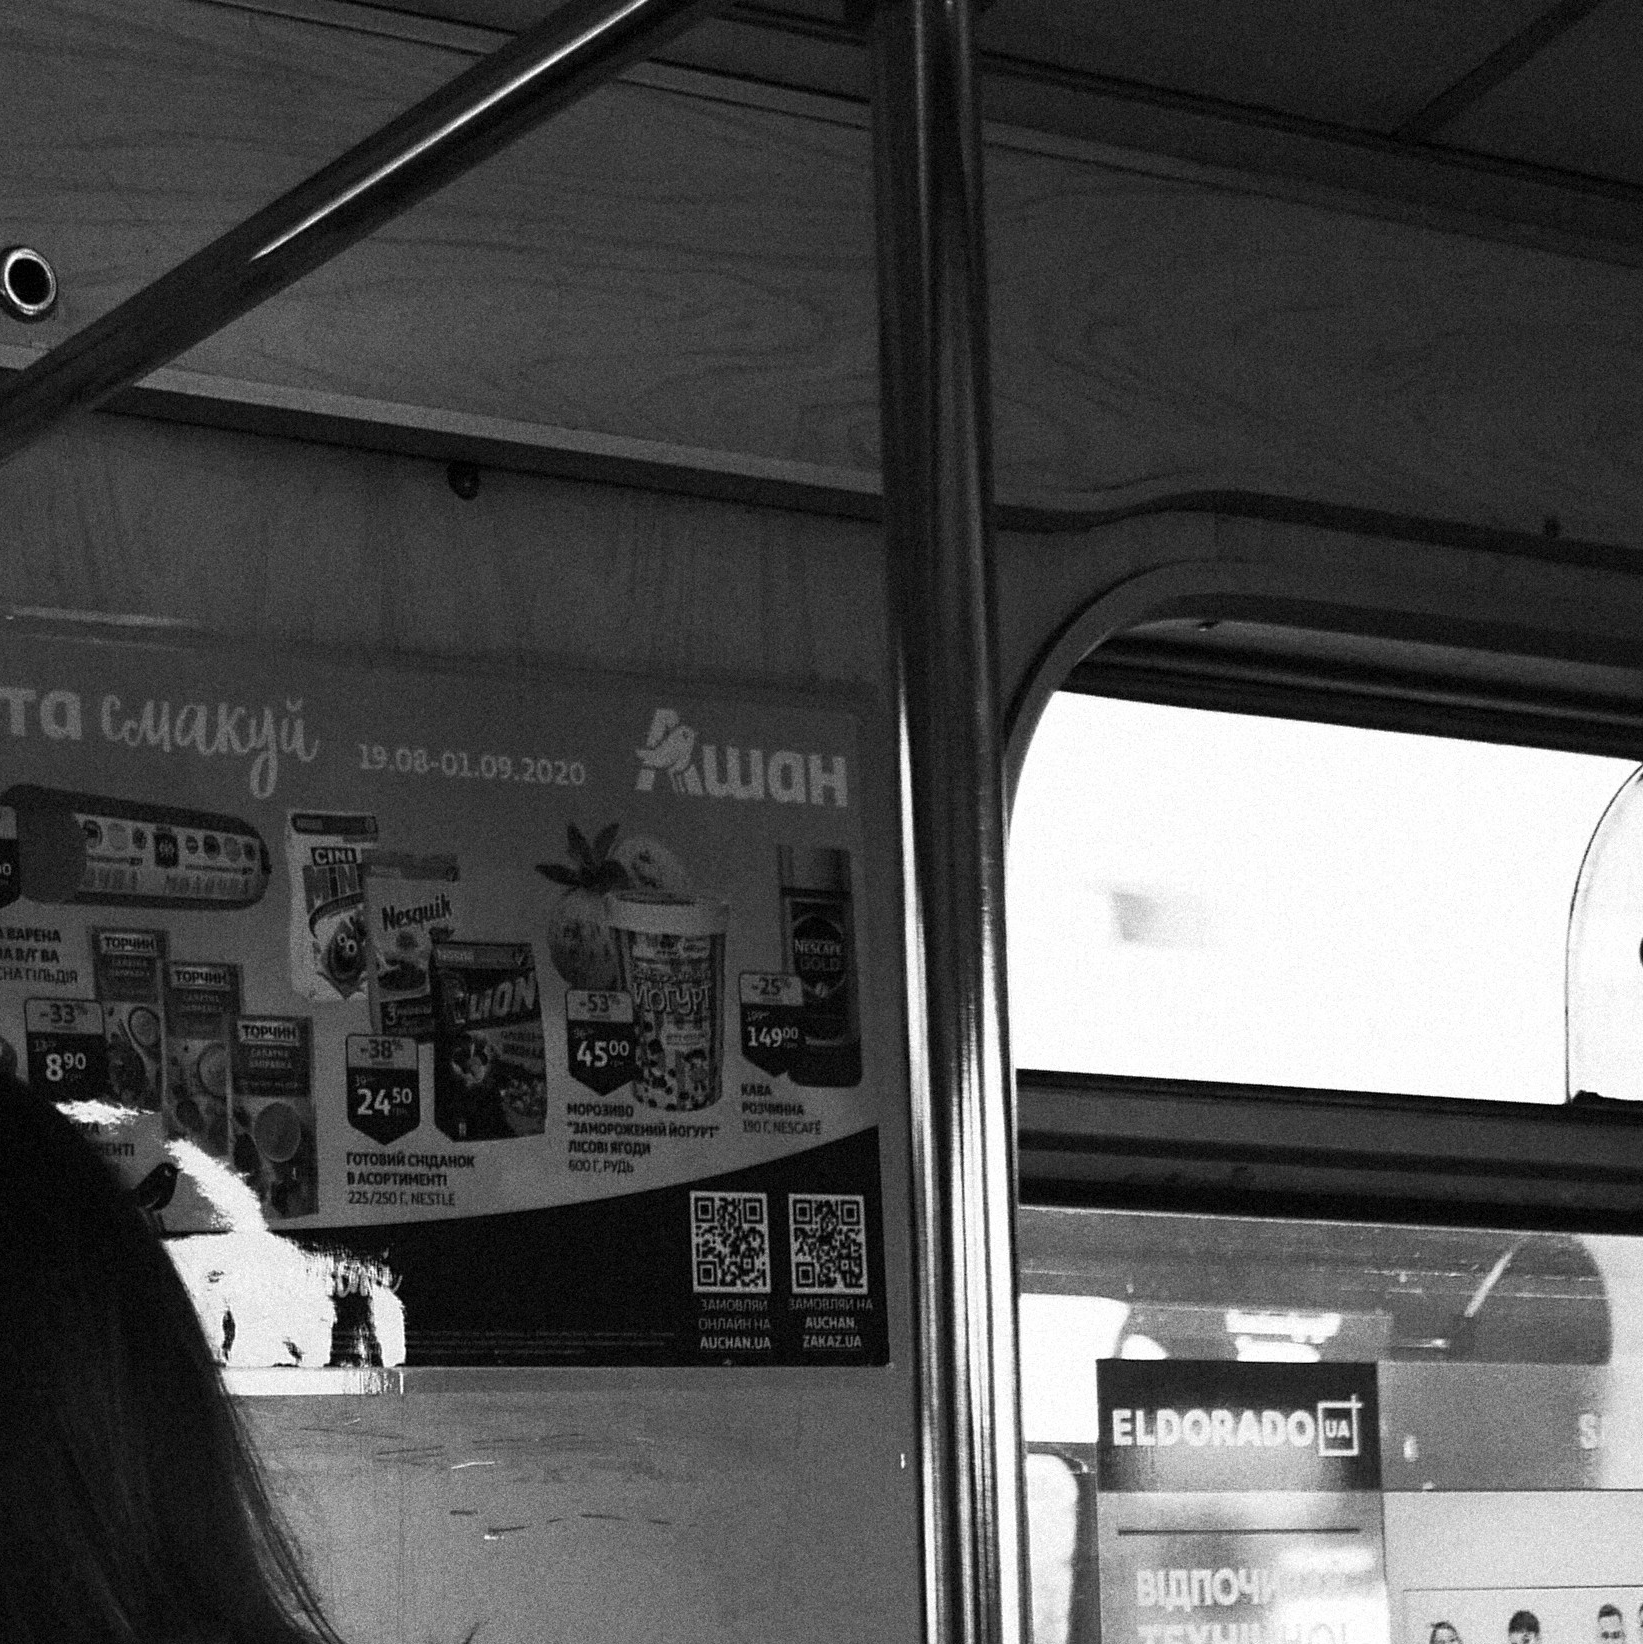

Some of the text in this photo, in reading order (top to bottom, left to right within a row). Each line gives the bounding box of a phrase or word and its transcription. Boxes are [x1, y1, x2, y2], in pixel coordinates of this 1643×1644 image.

[99, 694, 320, 800] смакуй
[357, 742, 587, 787] 19.08-01.09.2020
[314, 849, 356, 865] CINI
[381, 893, 453, 932] Nesquik
[6, 926, 63, 944] ВАРЕНА
[103, 936, 156, 951] ТОРЧИН
[800, 956, 842, 972] GOLD
[25, 968, 79, 986] ГІЛЬДІЯ
[174, 969, 230, 986] ТОРЧИН
[241, 1024, 298, 1041] ТОРЧИН
[740, 1083, 773, 1097] КАВА
[566, 1102, 634, 1118] МОРОЗИВО
[741, 1101, 805, 1116] РОЗЧИННА
[567, 1139, 652, 1157] ЛІСОВІ ЯГОДИ
[345, 1149, 476, 1171] ГОТОВИЙ СНІДАНОК
[603, 1159, 635, 1175] РУДЬ
[346, 1171, 448, 1187] В АСОРТИМЕНТІ
[348, 1191, 398, 1206] 225/250
[410, 1191, 456, 1208] NESTLE
[700, 1296, 769, 1312] ЗАМОВЛЯЙ
[787, 1296, 875, 1312] ЗАМОВЛЯЙ НА
[697, 1315, 773, 1332] ОНЛАЙН НА
[699, 1335, 773, 1350] AUCHAN.UA
[802, 1334, 863, 1350] ZAKAZ.UA
[1111, 1408, 1351, 1447] ELDORADO UA
